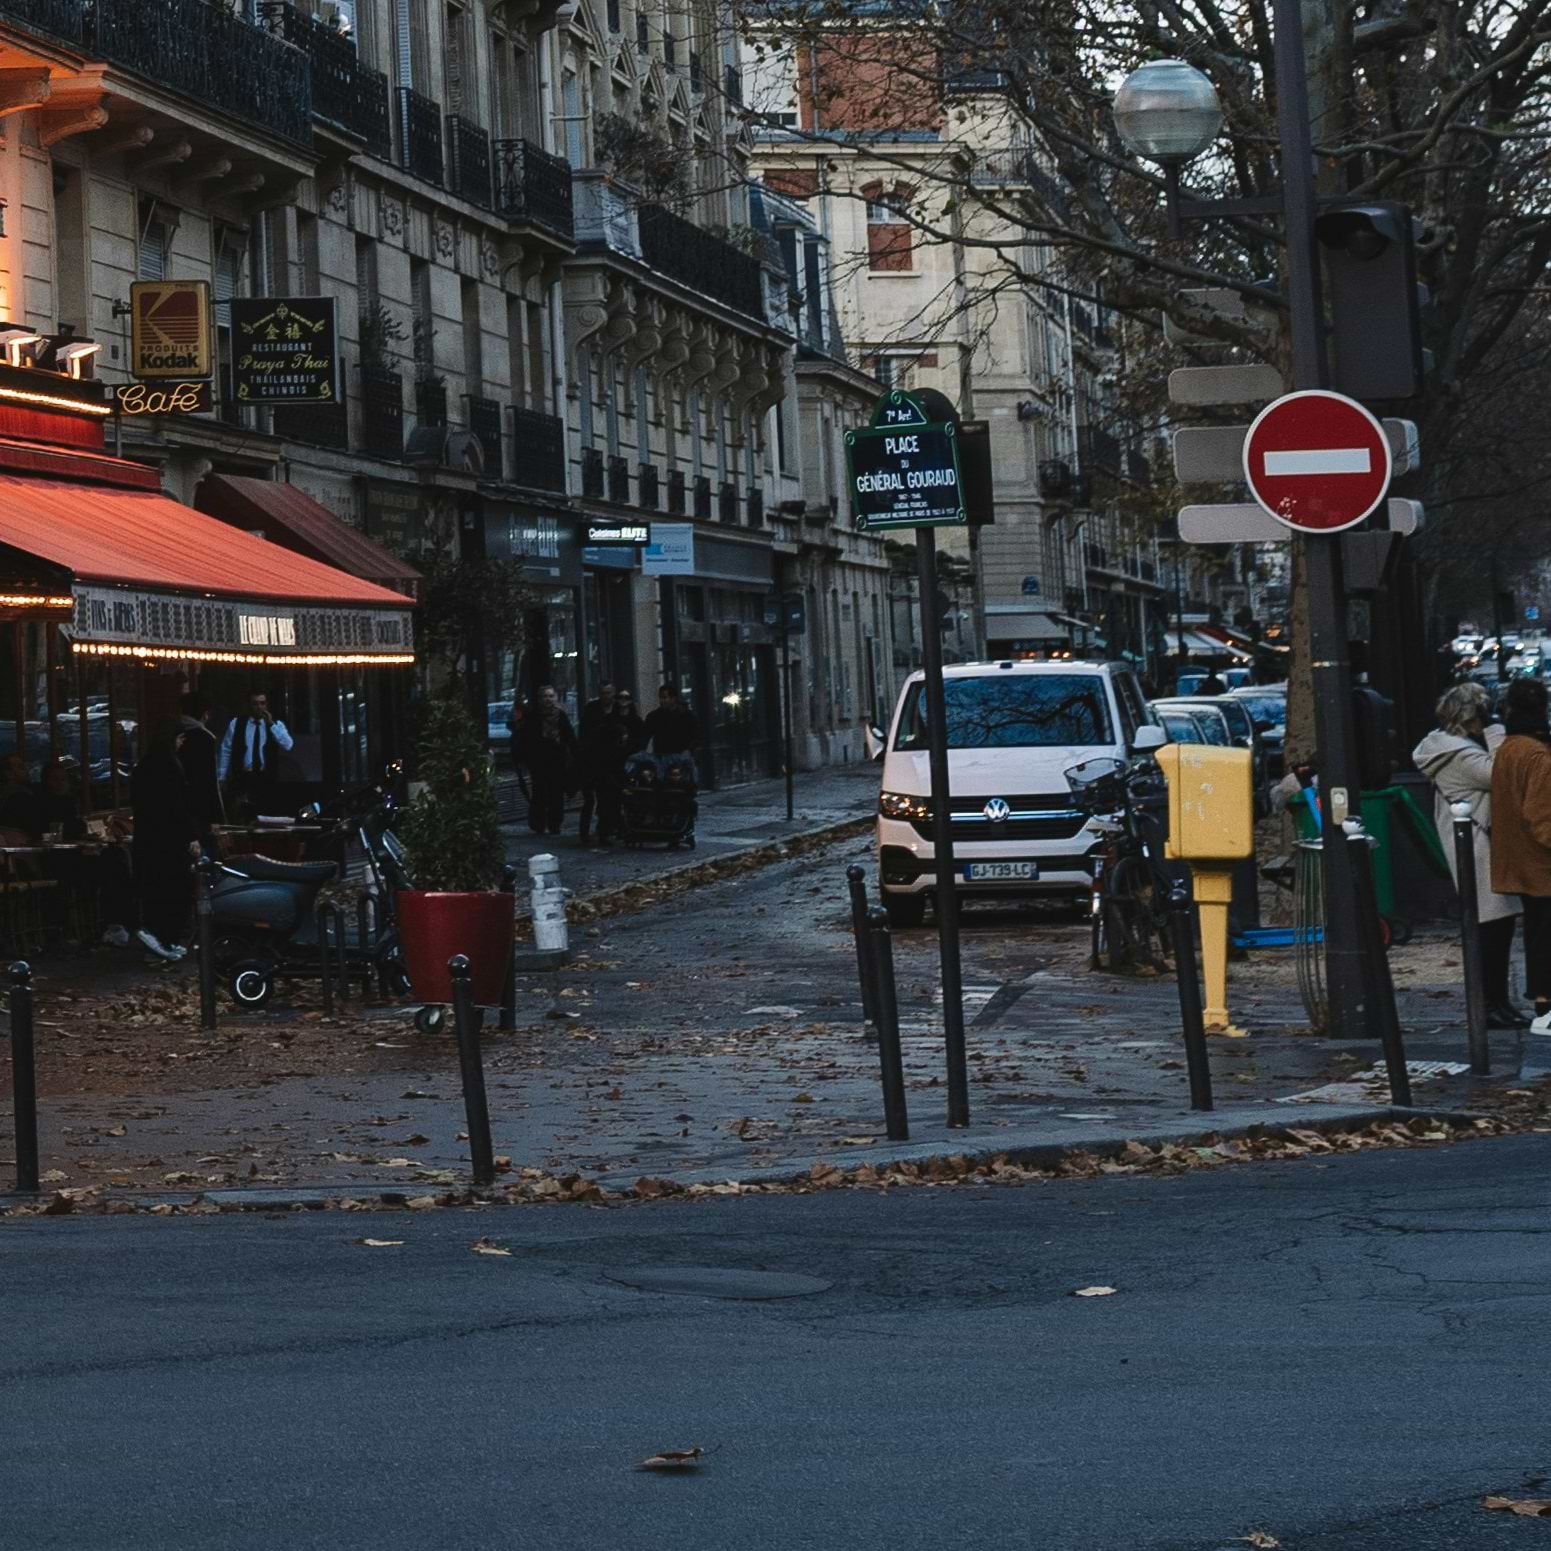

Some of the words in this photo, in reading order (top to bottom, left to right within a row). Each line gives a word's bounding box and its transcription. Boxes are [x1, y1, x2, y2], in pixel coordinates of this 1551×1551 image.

[140, 344, 199, 353] PRODUITS
[252, 342, 312, 352] RESTAURANT
[140, 353, 199, 369] Kodak
[238, 354, 285, 375] Praya
[250, 374, 316, 383] THAILANDAIS
[261, 385, 307, 395] CHINOIS
[117, 383, 204, 414] Café
[885, 435, 920, 455] PLACE
[900, 459, 909, 468] DU
[857, 470, 904, 493] GÉNÉRAL
[907, 469, 956, 489] GOURAUD
[972, 863, 1029, 877] GJ-739-LC
